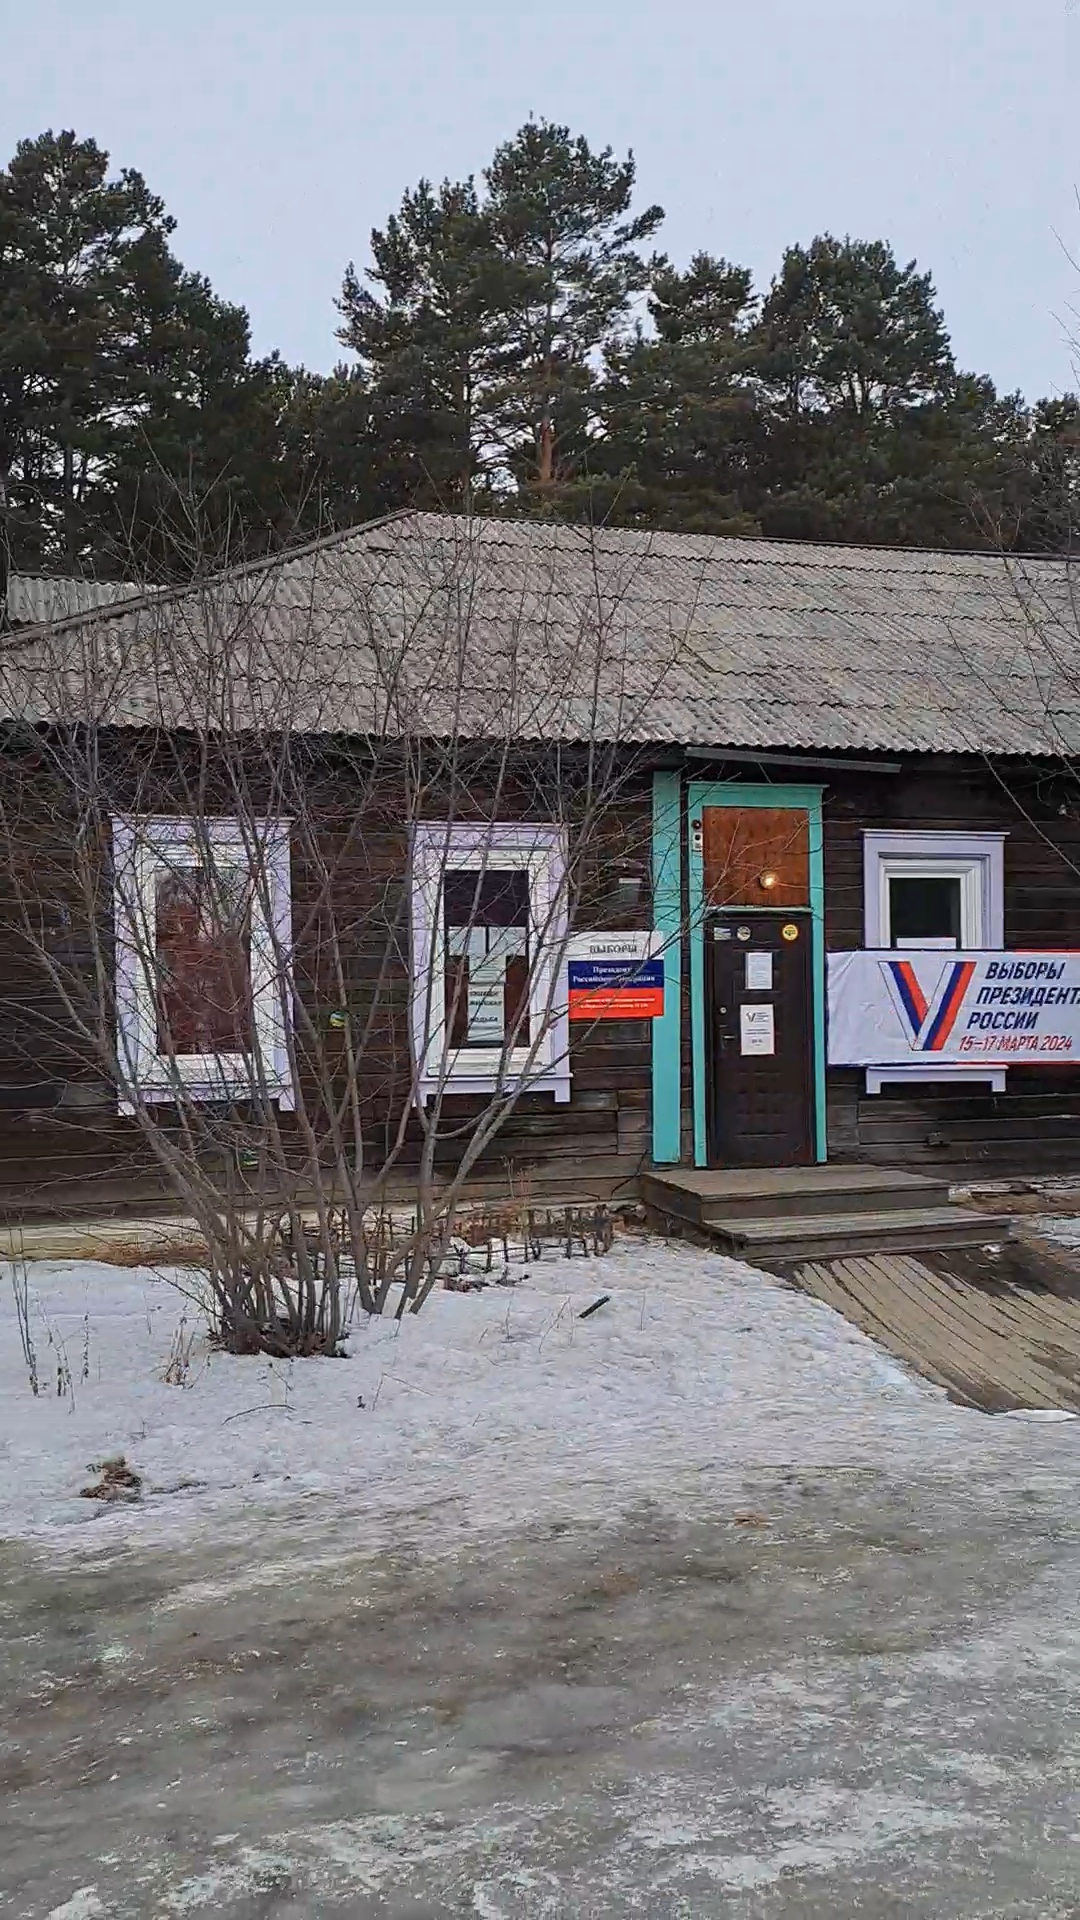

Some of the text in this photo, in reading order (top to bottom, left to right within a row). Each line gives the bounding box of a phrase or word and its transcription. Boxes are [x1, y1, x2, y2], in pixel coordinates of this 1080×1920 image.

[985, 962, 1066, 980] ВЫБОРЫ
[976, 987, 1080, 1006] ПРЕЗИДЕНТ
[967, 1012, 1039, 1029] РОССИИ
[997, 1035, 1038, 1051] МАРТА
[1040, 1035, 1073, 1051] 2024
